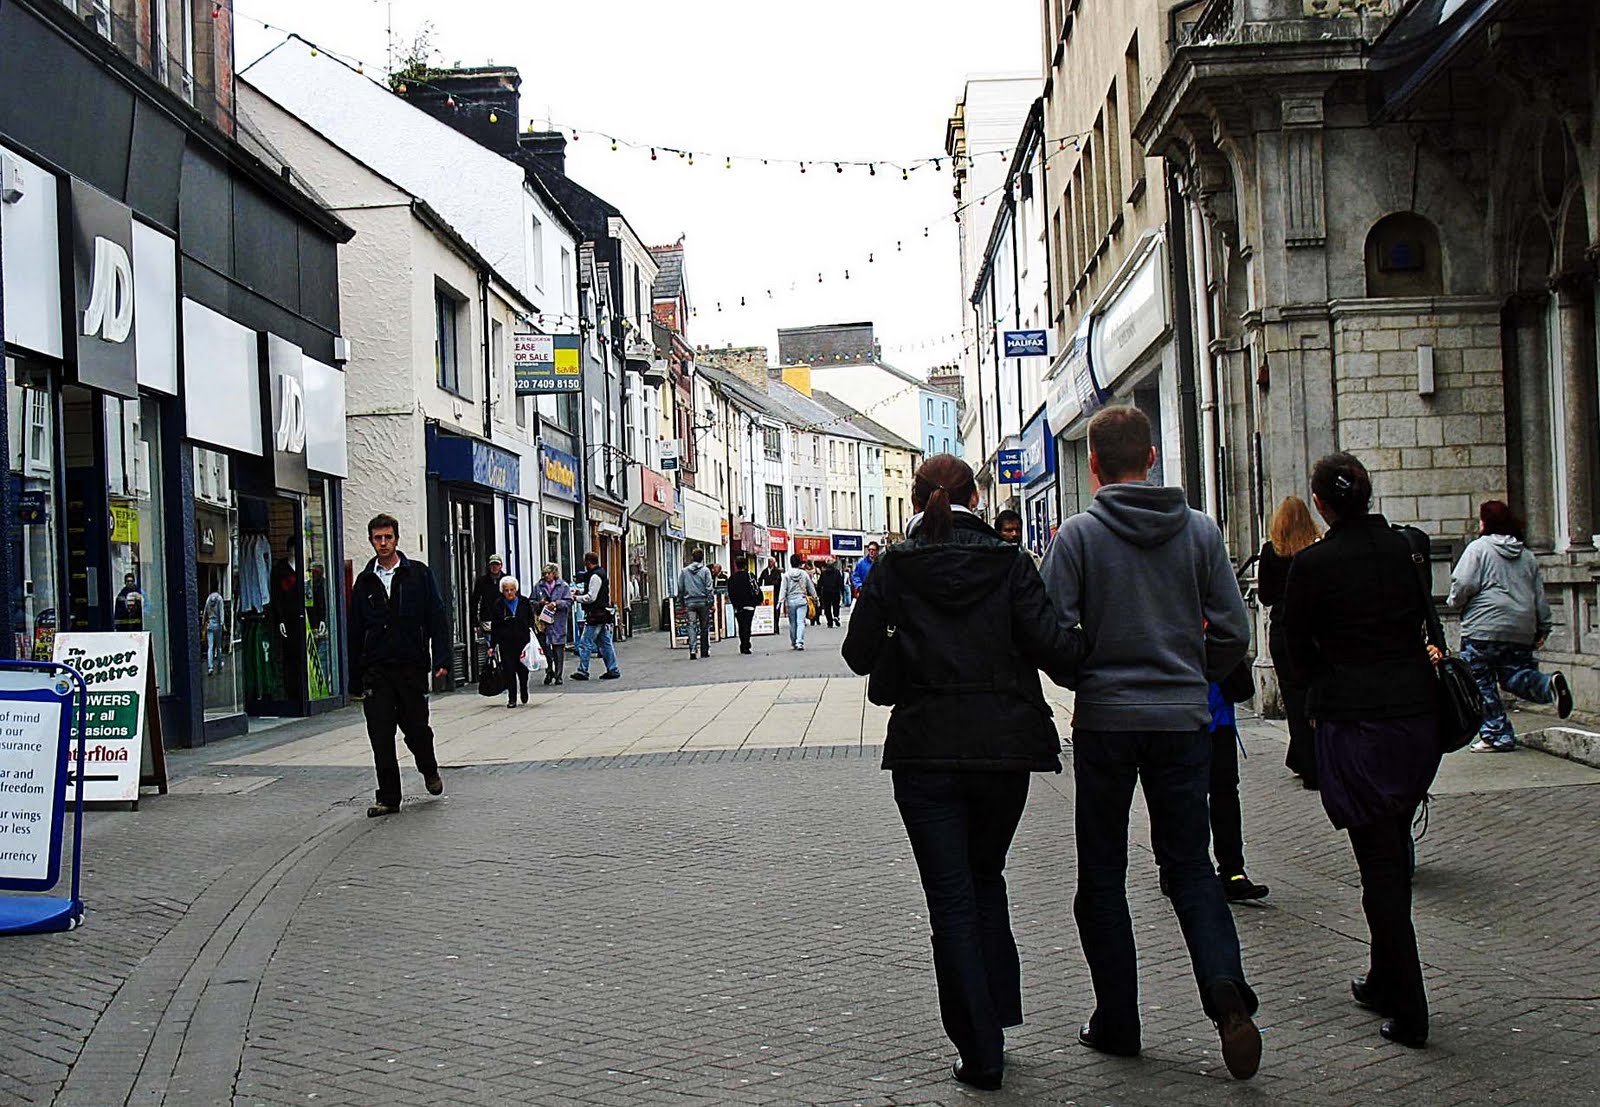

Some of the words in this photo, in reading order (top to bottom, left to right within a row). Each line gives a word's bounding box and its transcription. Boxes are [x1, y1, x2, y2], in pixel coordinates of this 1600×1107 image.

[84, 236, 134, 343] JD
[1007, 339, 1044, 347] HALIFAX
[514, 353, 527, 361] OR
[529, 353, 549, 361] SALE
[532, 379, 555, 389] 7409
[557, 379, 580, 389] 8150
[68, 648, 86, 656] The
[61, 651, 137, 675] Flower
[13, 712, 41, 723] mind
[100, 709, 115, 721] all
[5, 728, 24, 736] our
[70, 725, 128, 736] casions
[0, 742, 42, 752] surance
[13, 768, 34, 779] and
[0, 781, 44, 794] freedom
[12, 808, 42, 823] wings
[12, 822, 31, 834] less
